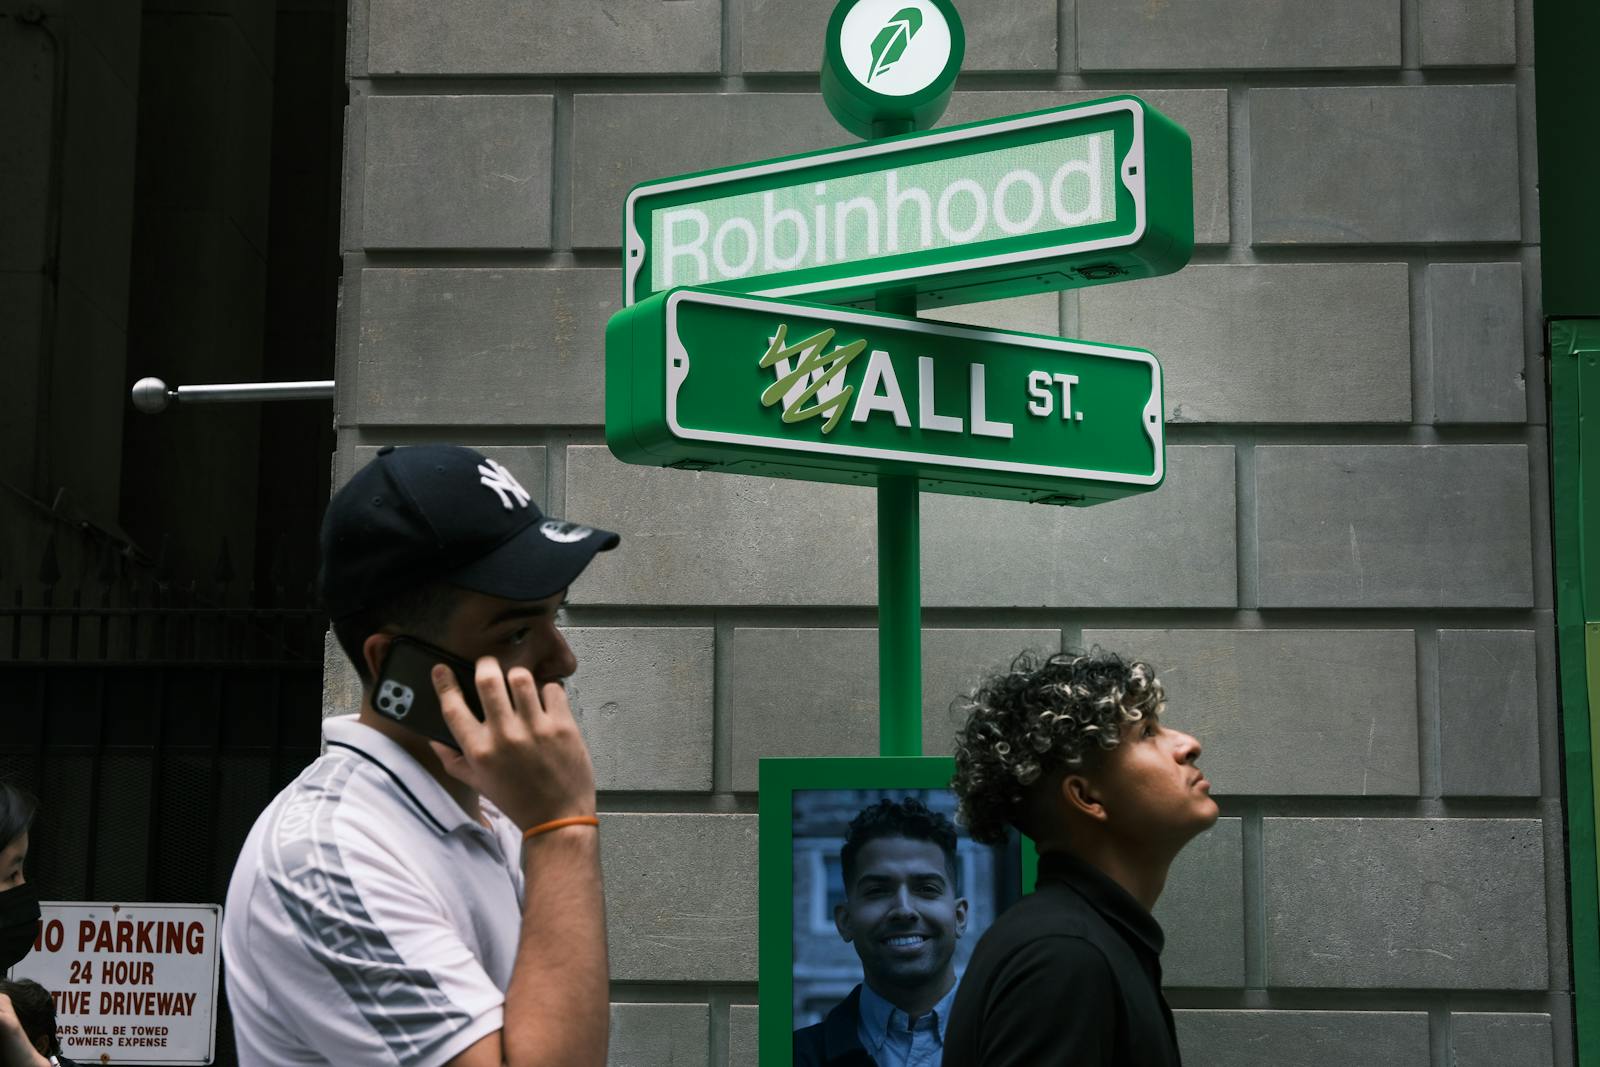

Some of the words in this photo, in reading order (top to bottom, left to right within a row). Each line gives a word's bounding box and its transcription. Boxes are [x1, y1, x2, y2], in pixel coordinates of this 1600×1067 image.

[660, 133, 1103, 287] Robinhood
[767, 335, 1014, 439] WALL
[1028, 369, 1084, 421] ST.
[78, 919, 205, 955] PARKING
[69, 960, 93, 984] 24
[102, 961, 154, 985] HOUR
[51, 991, 91, 1015] TIVE
[100, 992, 197, 1016] DRIVEWAY
[56, 1025, 79, 1035] ARS
[84, 1025, 108, 1035] WILL
[112, 1026, 126, 1035] BE
[131, 1026, 169, 1036] TOWED
[67, 1036, 113, 1046] OWNERS
[118, 1037, 168, 1047] EXPENSE
